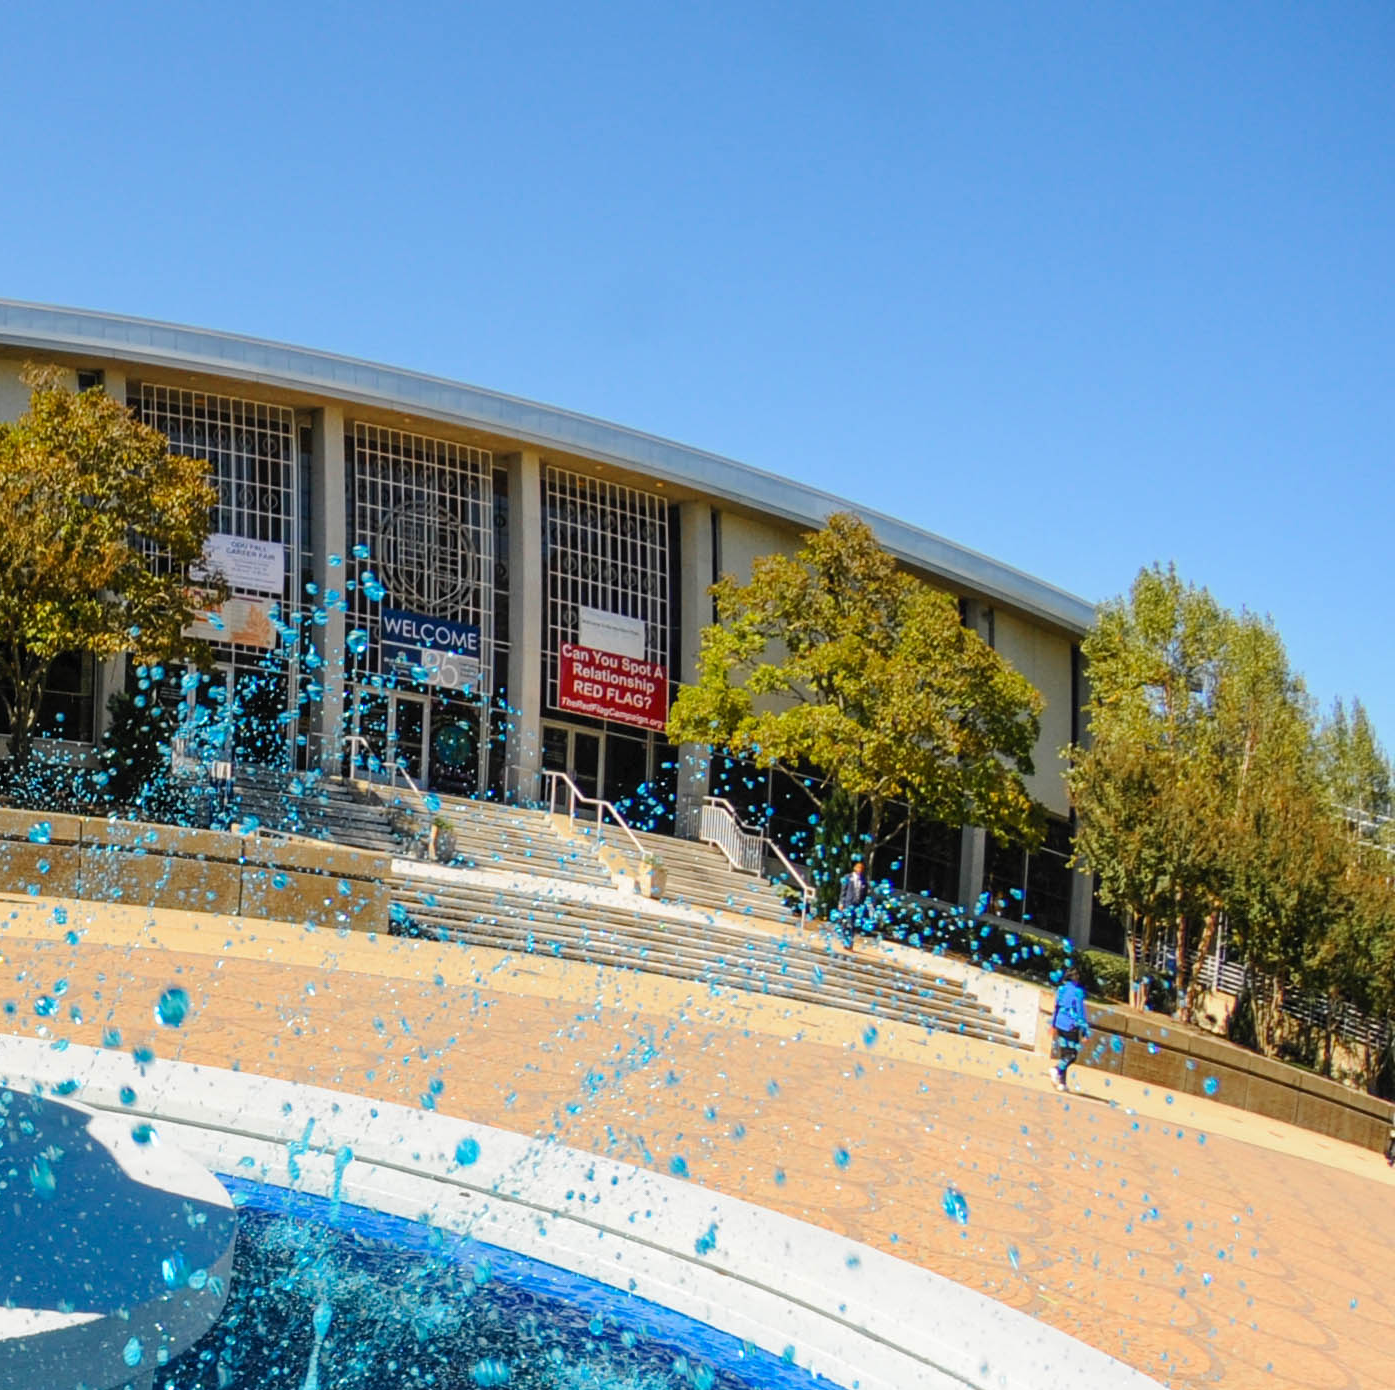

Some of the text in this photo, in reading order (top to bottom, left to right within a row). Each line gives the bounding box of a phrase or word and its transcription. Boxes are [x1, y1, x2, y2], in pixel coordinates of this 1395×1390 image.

[384, 615, 477, 651] WELCOME
[562, 644, 664, 679] Can You Spot A
[572, 661, 655, 695] Relationship
[573, 679, 652, 710] RED FLAG?
[561, 696, 663, 729] TheRedFlagCampaign.org
